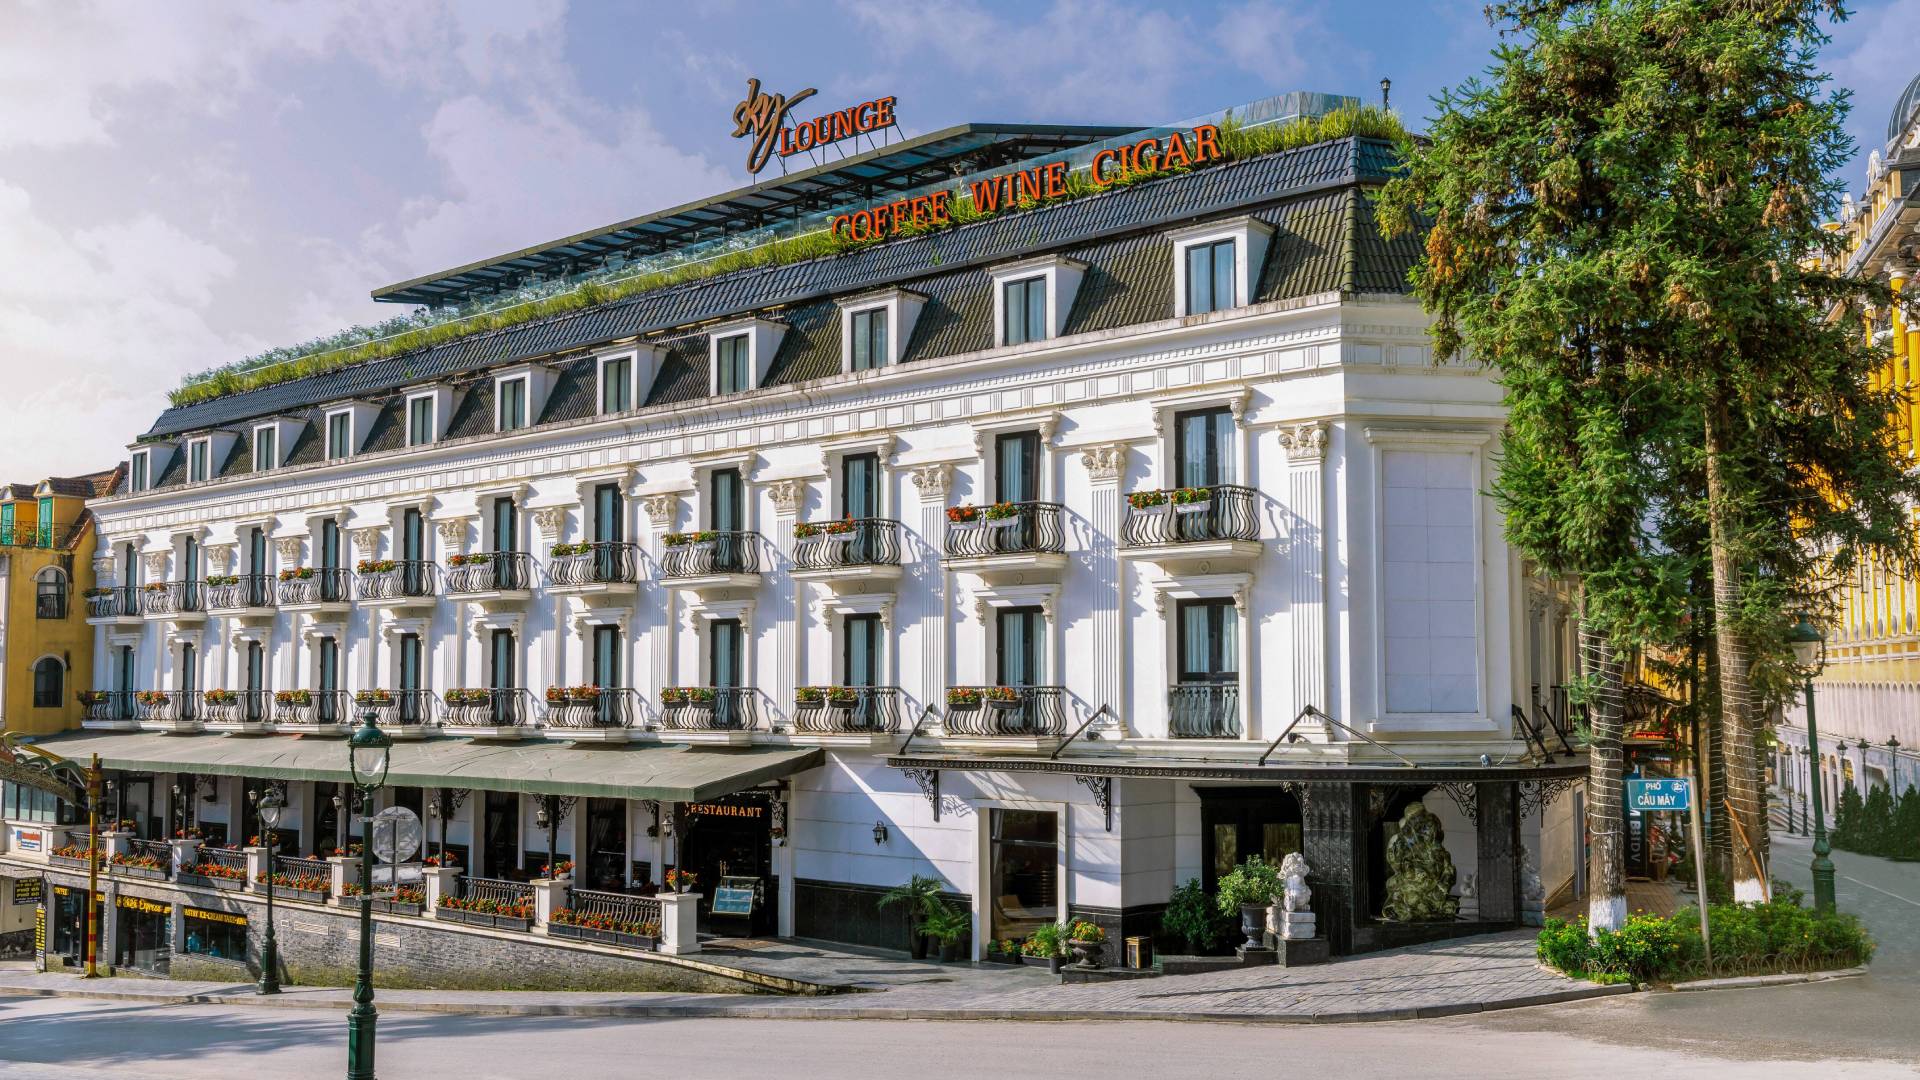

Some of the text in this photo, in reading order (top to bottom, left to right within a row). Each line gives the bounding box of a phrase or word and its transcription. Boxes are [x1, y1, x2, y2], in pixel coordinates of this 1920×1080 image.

[779, 95, 897, 157] LOUNGE
[831, 124, 1222, 243] COFFEE WINE CIGAR
[690, 804, 762, 818] RESTAURANT
